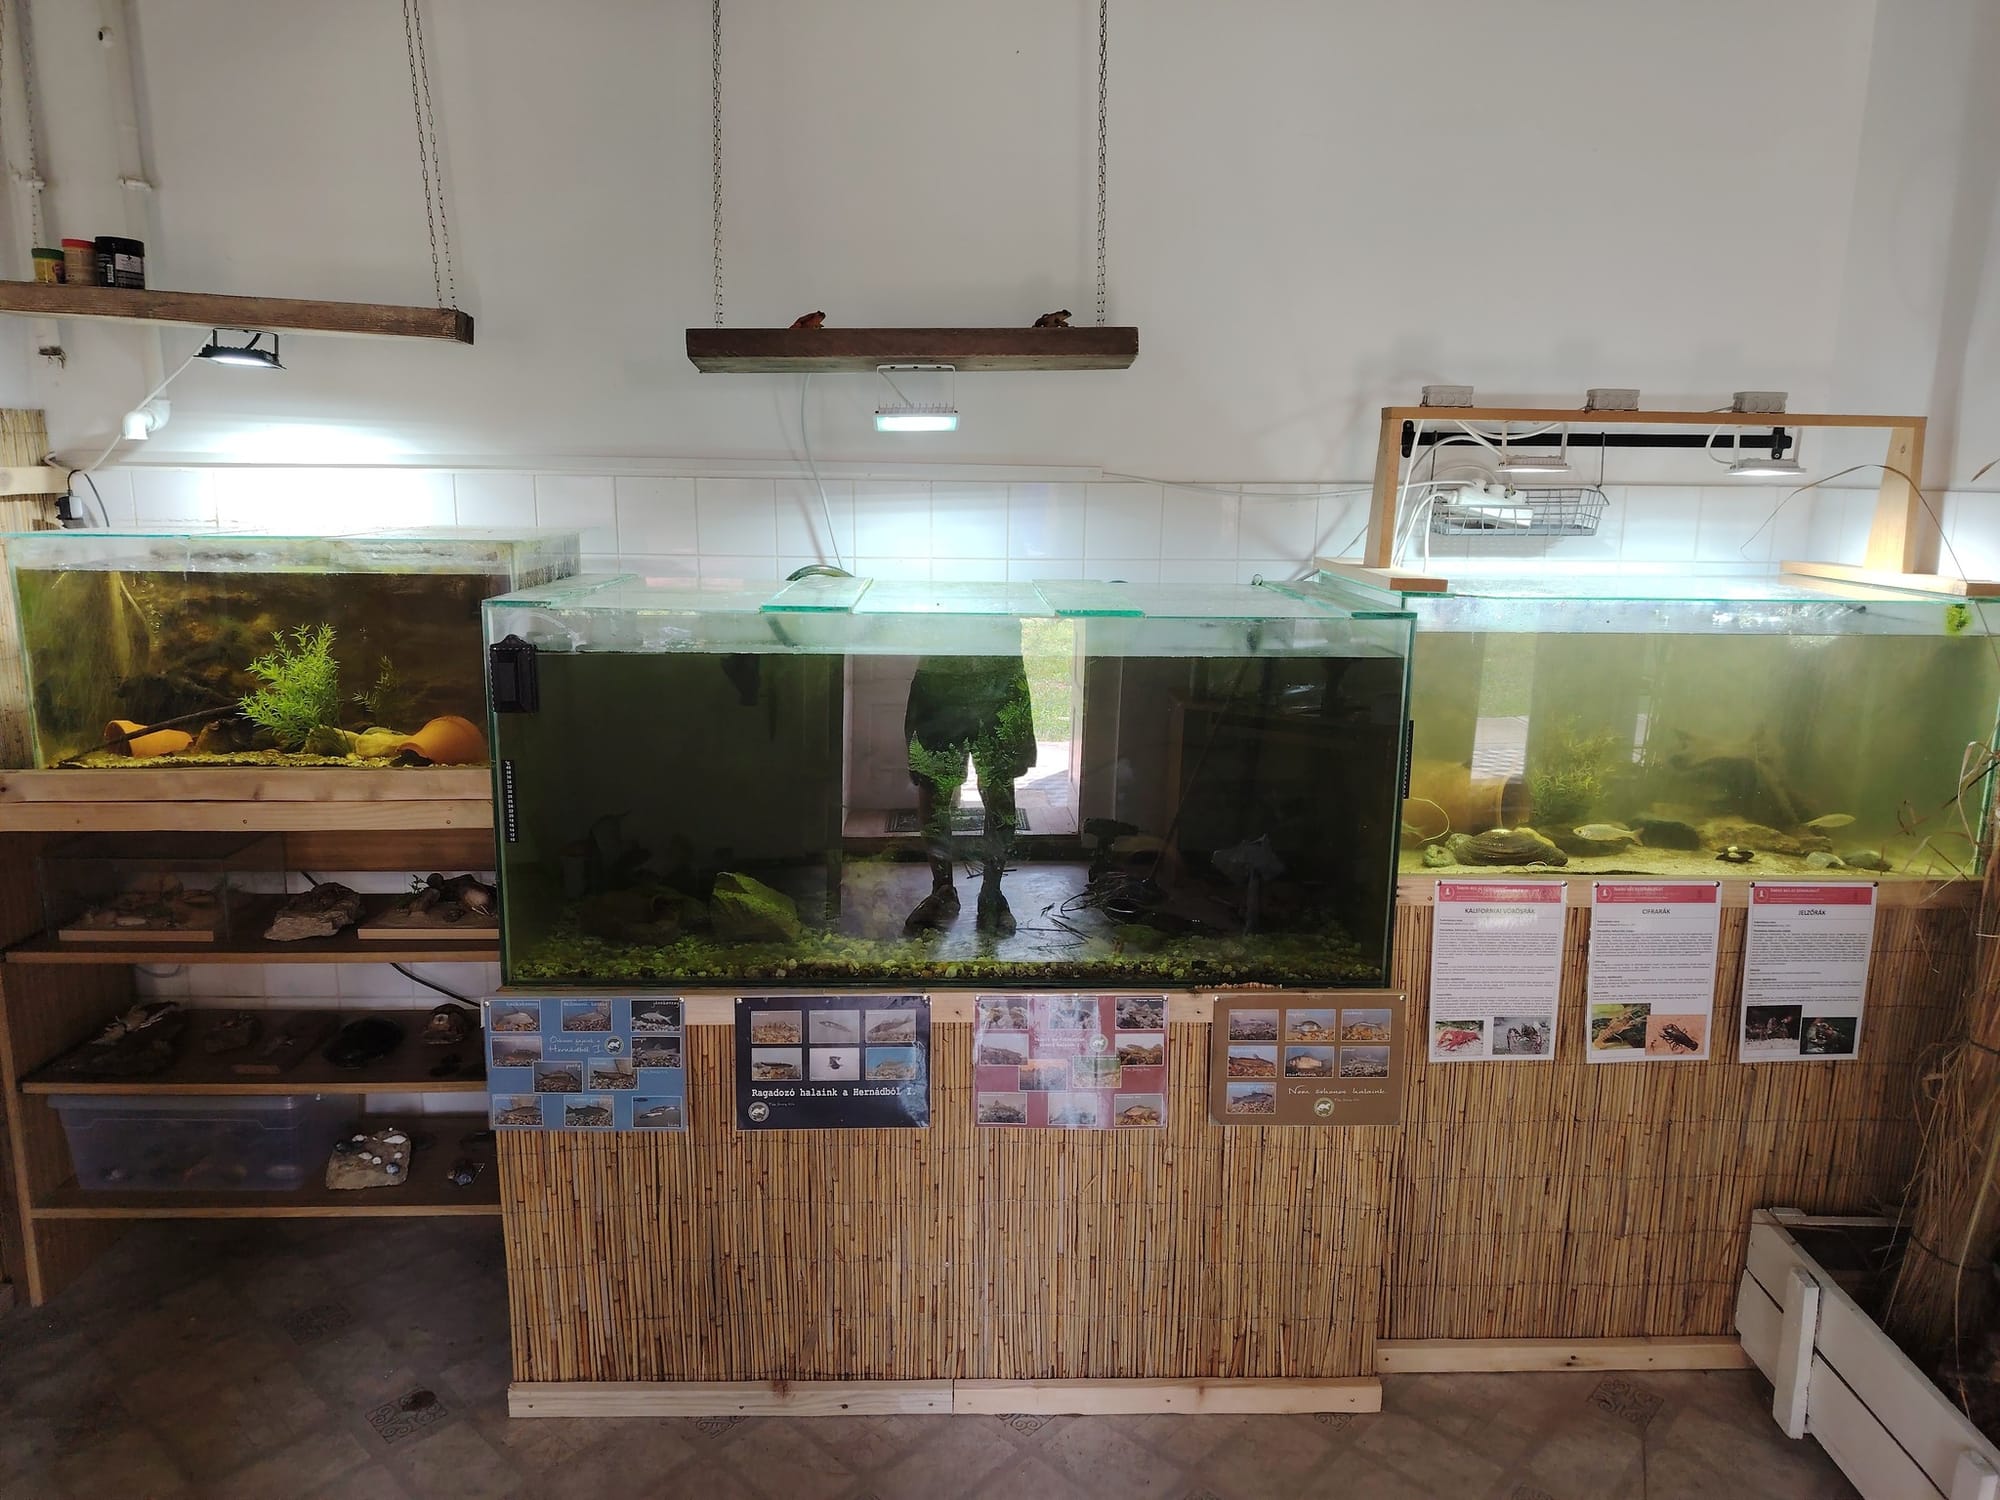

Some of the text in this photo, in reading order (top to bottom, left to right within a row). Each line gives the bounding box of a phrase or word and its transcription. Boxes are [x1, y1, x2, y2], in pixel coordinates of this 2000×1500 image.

[752, 1088, 796, 1099] Ragadozó
[800, 1088, 838, 1096] halaink
[853, 1086, 901, 1096] Hernádból
[906, 1088, 916, 1096] I.
[1288, 1084, 1310, 1094] Nem
